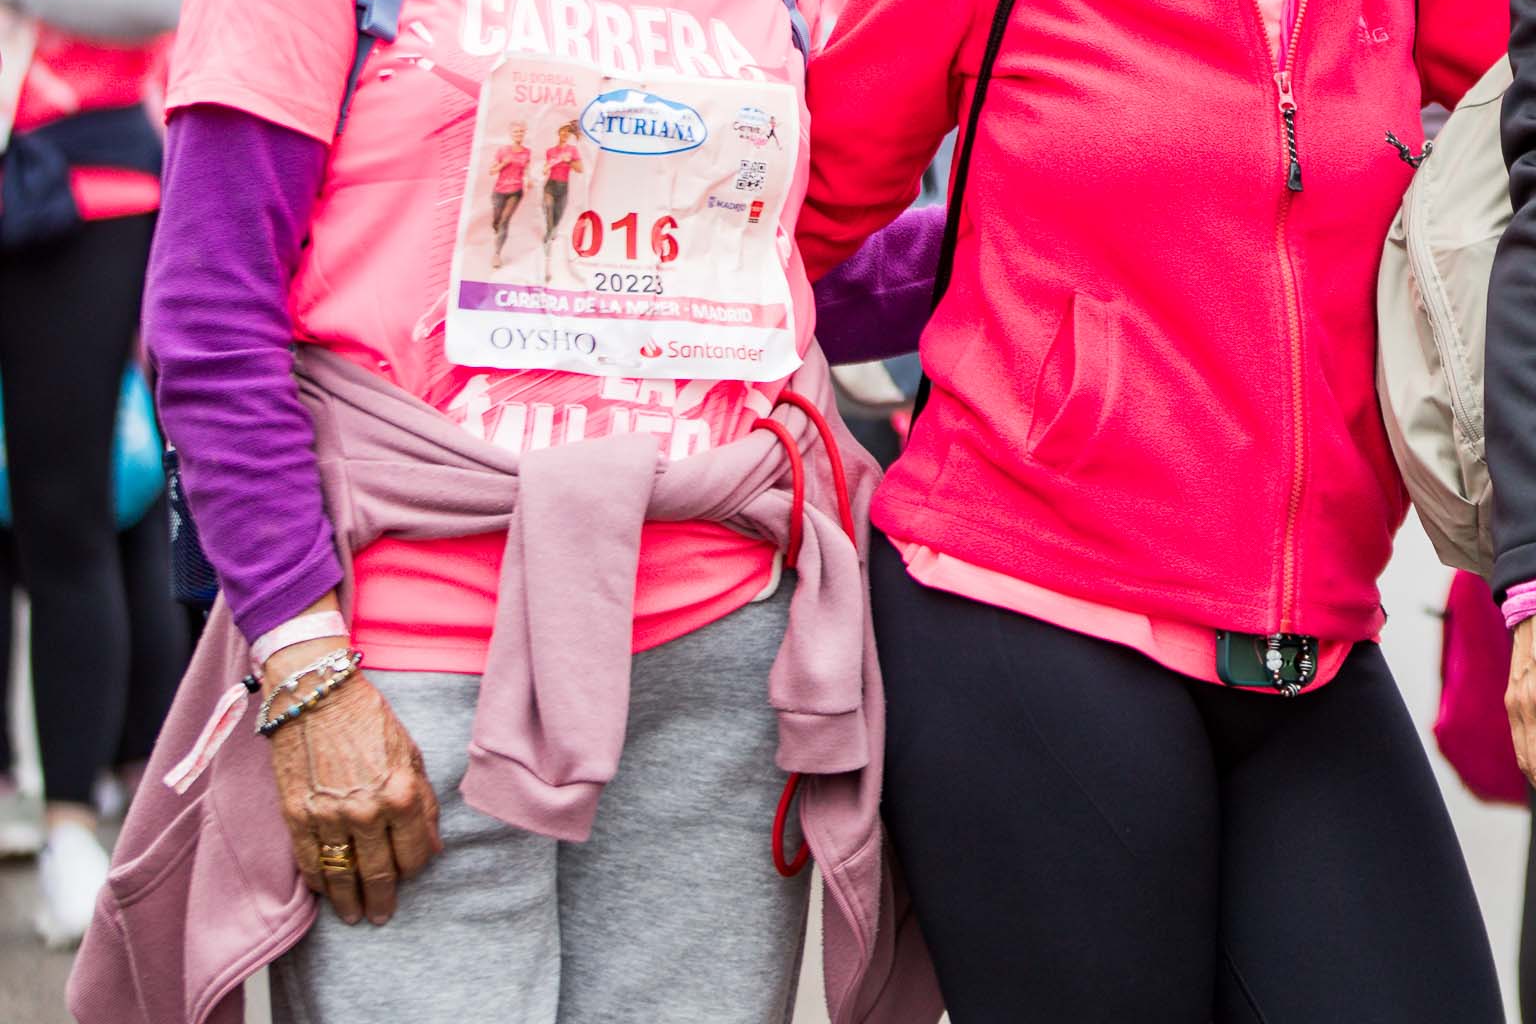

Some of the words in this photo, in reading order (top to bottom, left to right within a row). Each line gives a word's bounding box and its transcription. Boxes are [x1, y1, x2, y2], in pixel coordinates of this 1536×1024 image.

[514, 85, 577, 107] SUMA
[590, 112, 696, 143] ATURIANA
[572, 210, 680, 263] 016
[573, 297, 597, 313] DE
[600, 299, 620, 314] LA
[690, 303, 753, 322] MADRID
[490, 327, 597, 355] OYSHO
[668, 340, 765, 362] Santander
